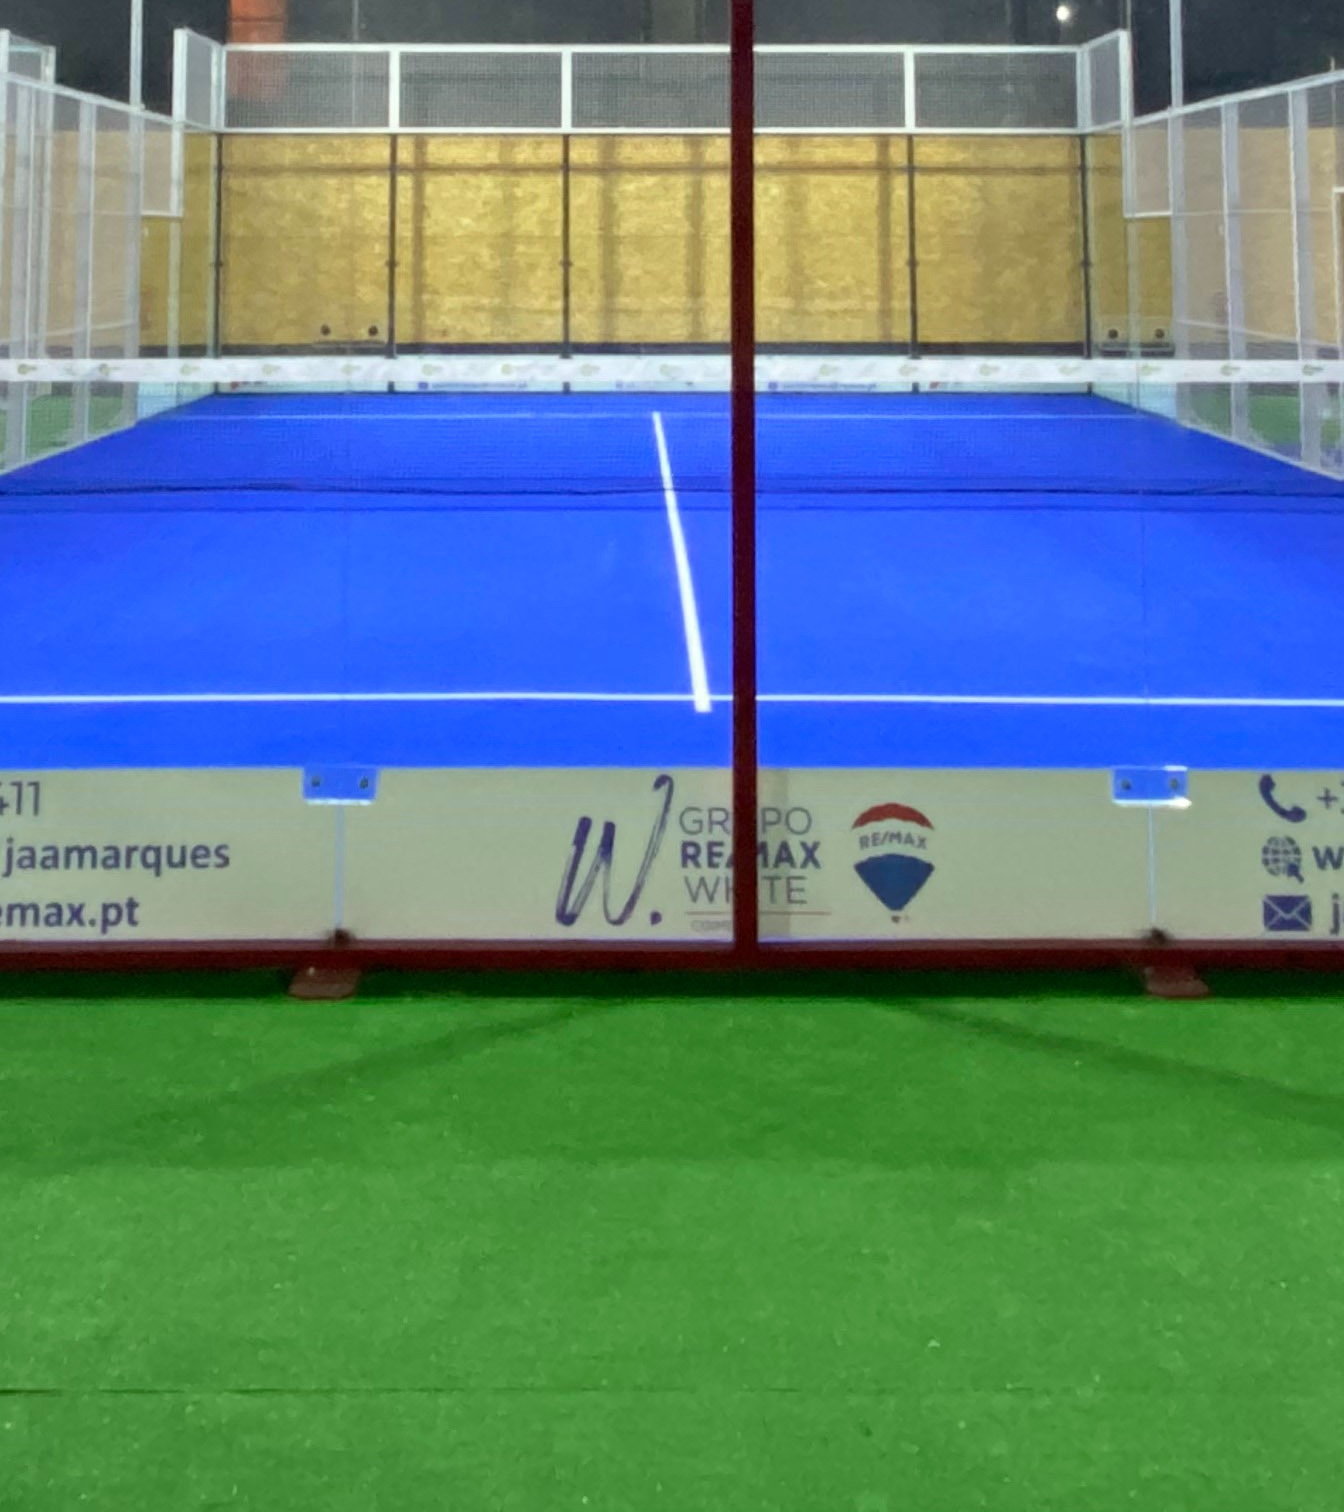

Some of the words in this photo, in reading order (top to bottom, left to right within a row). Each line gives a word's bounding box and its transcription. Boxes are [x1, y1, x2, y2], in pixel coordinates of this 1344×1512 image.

[678, 806, 813, 836] GRPO
[859, 831, 928, 850] RE/MAX
[683, 874, 808, 905] WTE
